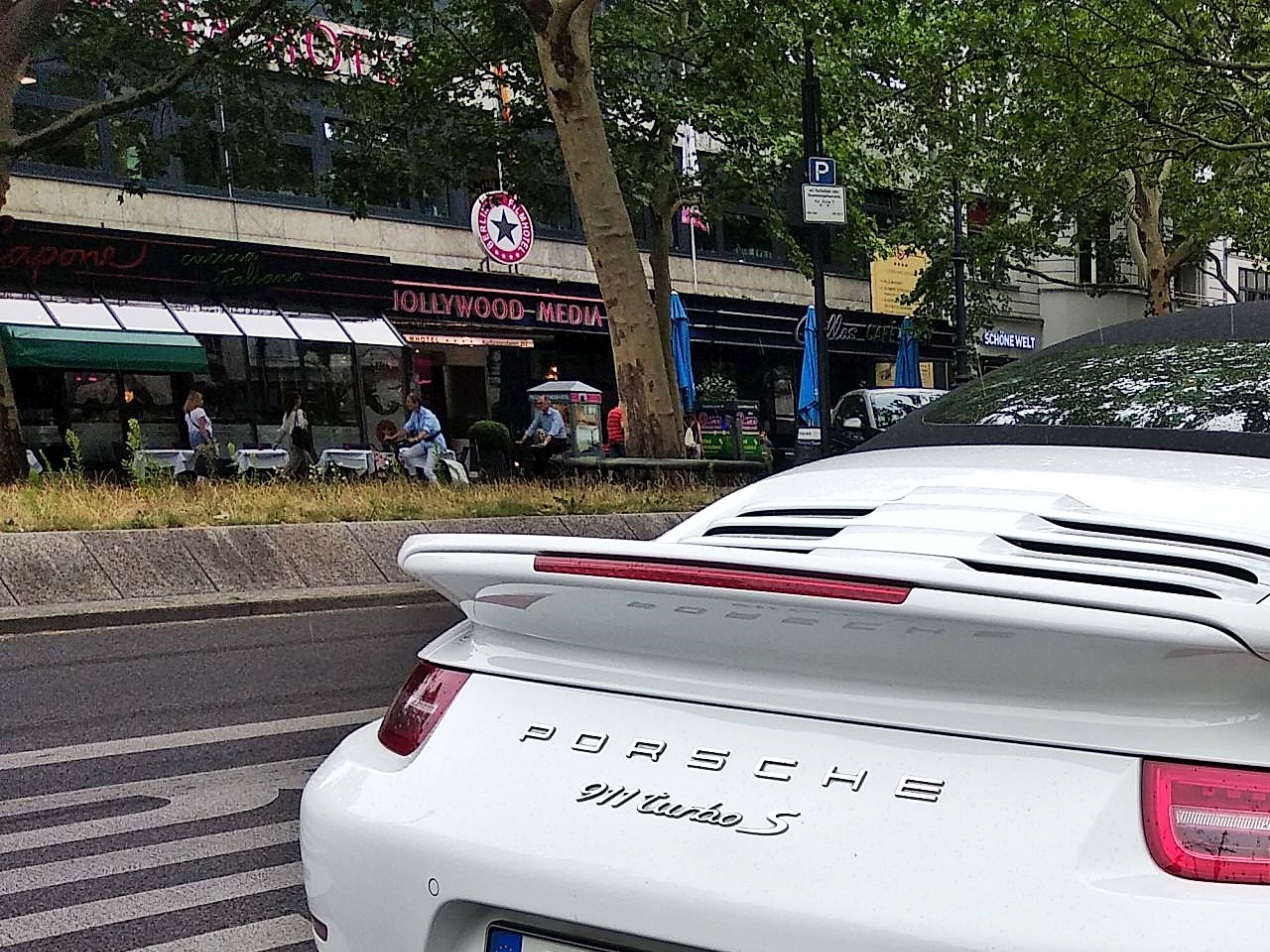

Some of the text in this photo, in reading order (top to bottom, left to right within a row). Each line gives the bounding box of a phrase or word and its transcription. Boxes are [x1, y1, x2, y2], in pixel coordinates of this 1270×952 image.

[815, 161, 829, 181] P
[507, 198, 531, 254] FILMHOTEL
[0, 241, 149, 286] apone
[535, 301, 604, 328] MEDIA
[984, 330, 1036, 349] SCHÖNE WELT
[518, 721, 946, 804] PORSCHE
[576, 782, 802, 836] 911 turbo S
